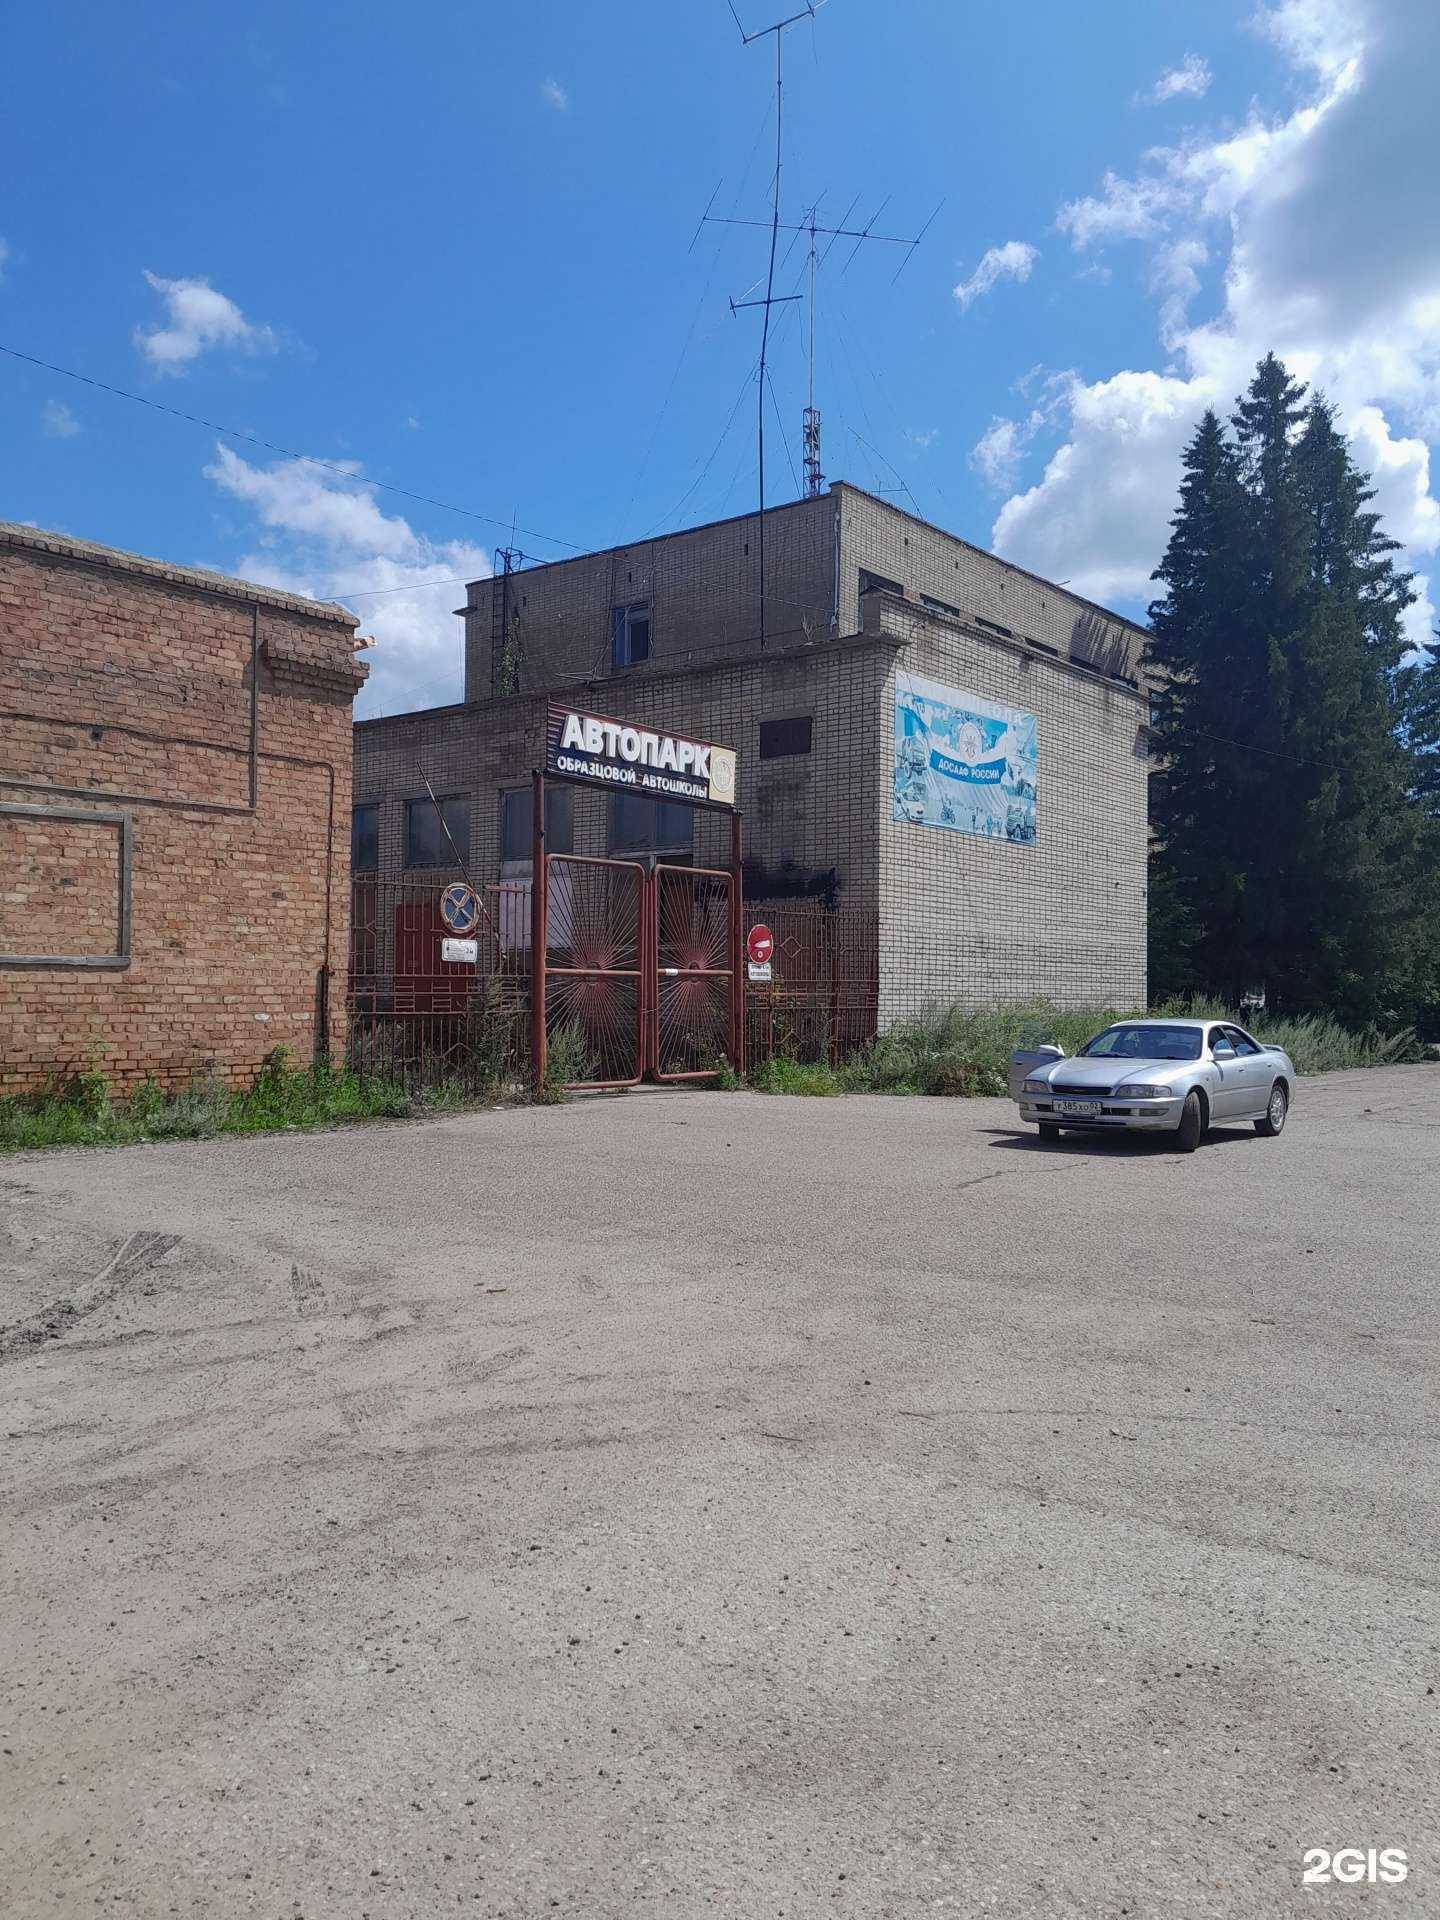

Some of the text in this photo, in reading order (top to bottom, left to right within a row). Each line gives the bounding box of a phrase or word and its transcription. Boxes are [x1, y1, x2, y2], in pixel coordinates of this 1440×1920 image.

[560, 715, 711, 779] АВТОПАРК
[557, 756, 708, 799] ОБРАЗЦОВОЙ АВТОШКОЛЫ
[971, 768, 1000, 779] РОССИИ
